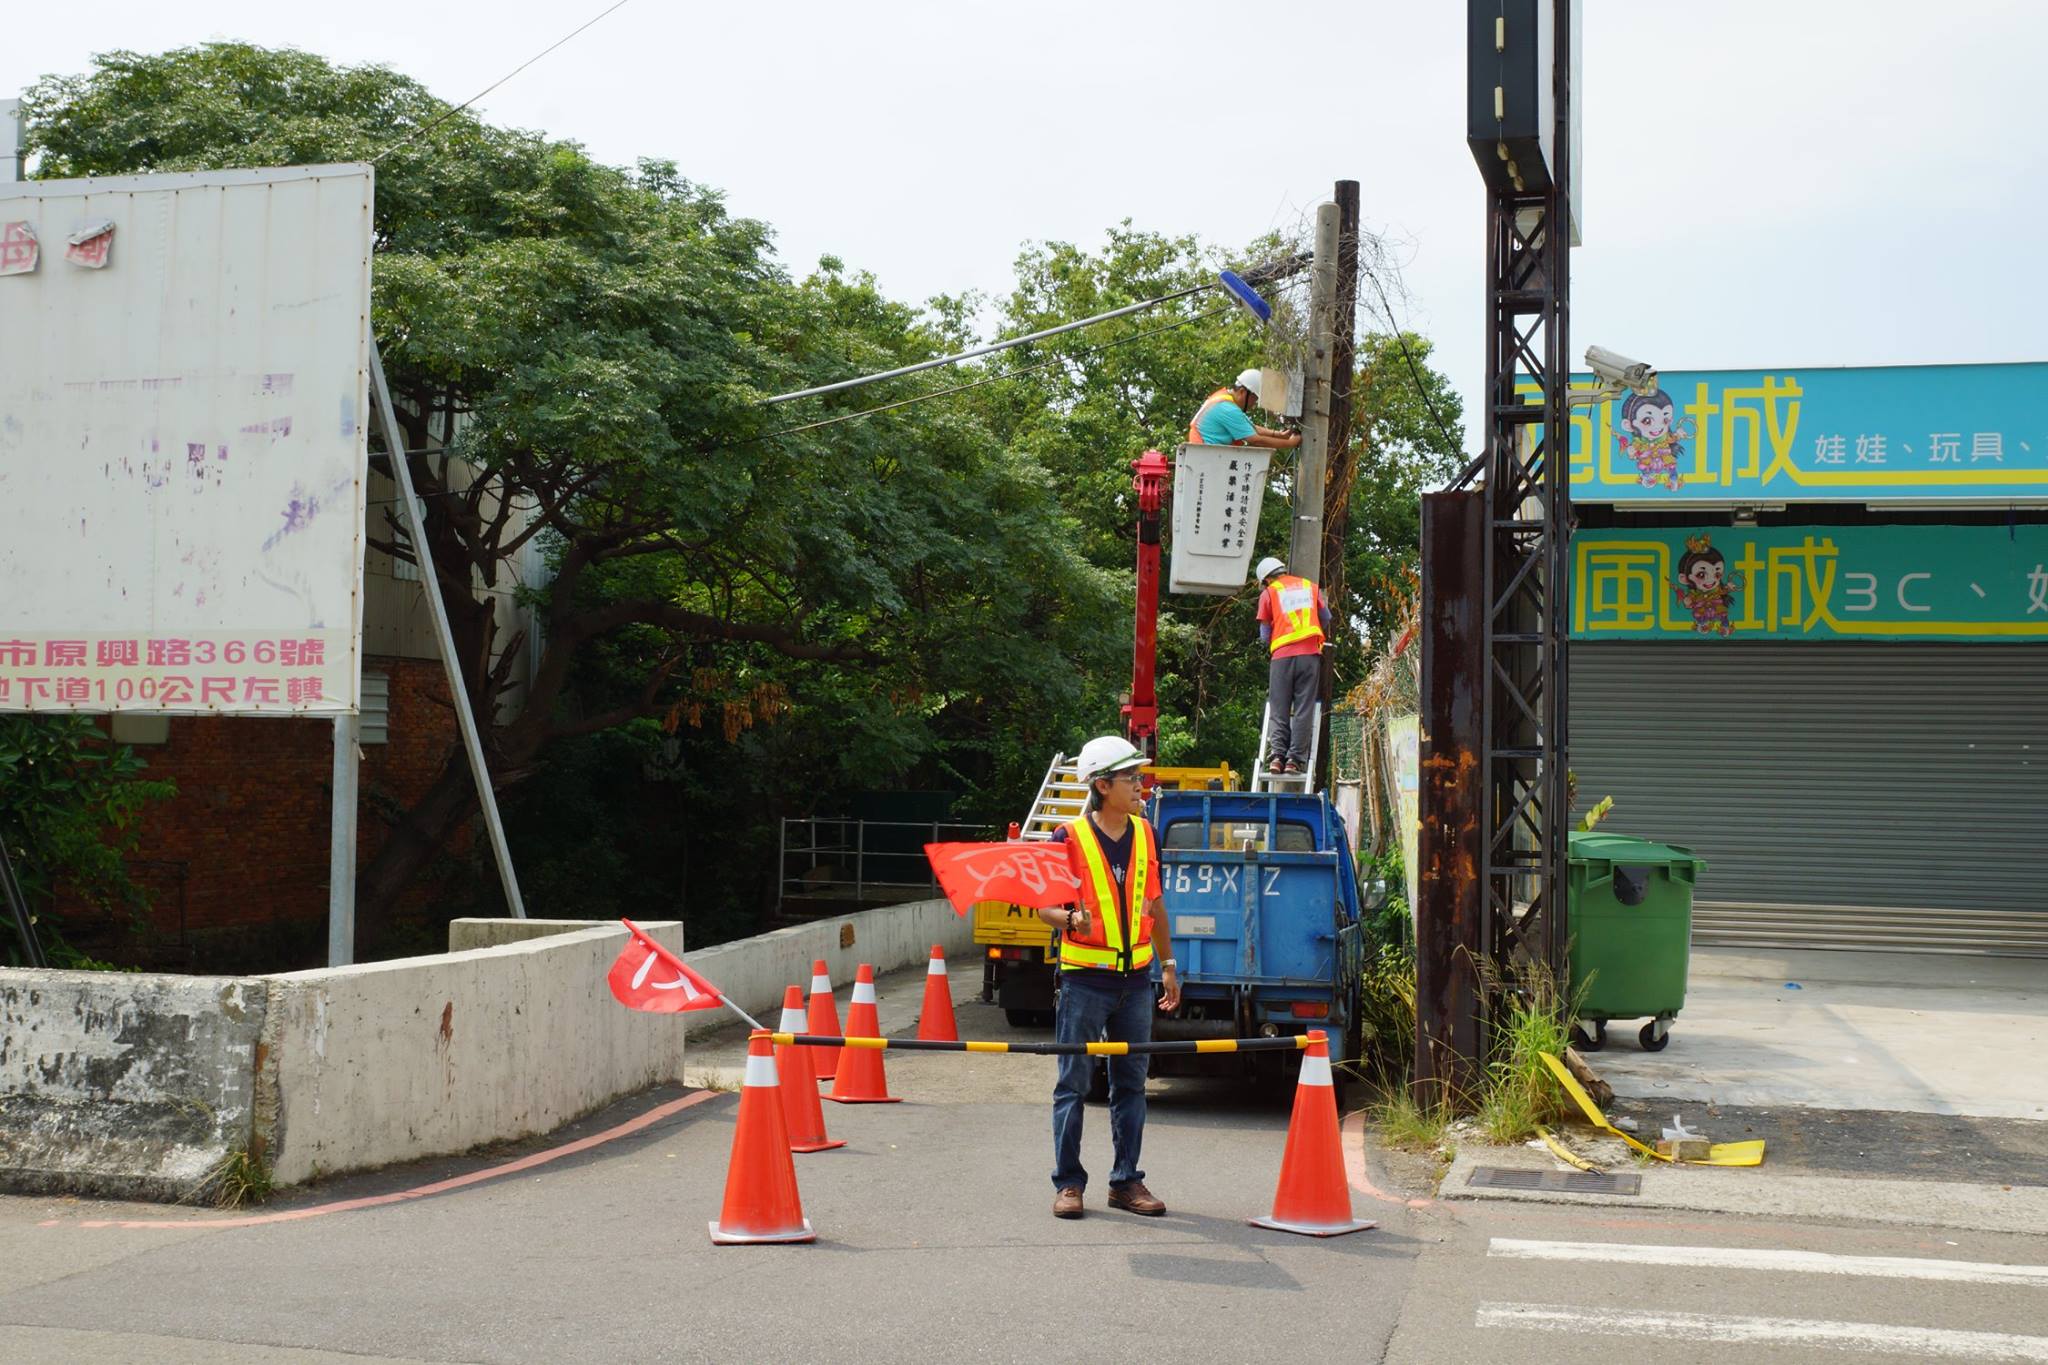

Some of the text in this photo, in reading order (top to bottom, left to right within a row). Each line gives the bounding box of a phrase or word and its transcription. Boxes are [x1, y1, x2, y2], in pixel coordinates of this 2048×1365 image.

[1814, 432, 2048, 464] 娃娃、玩具、
[1574, 536, 1839, 634] 風城
[0, 638, 325, 667] 市原興路366號
